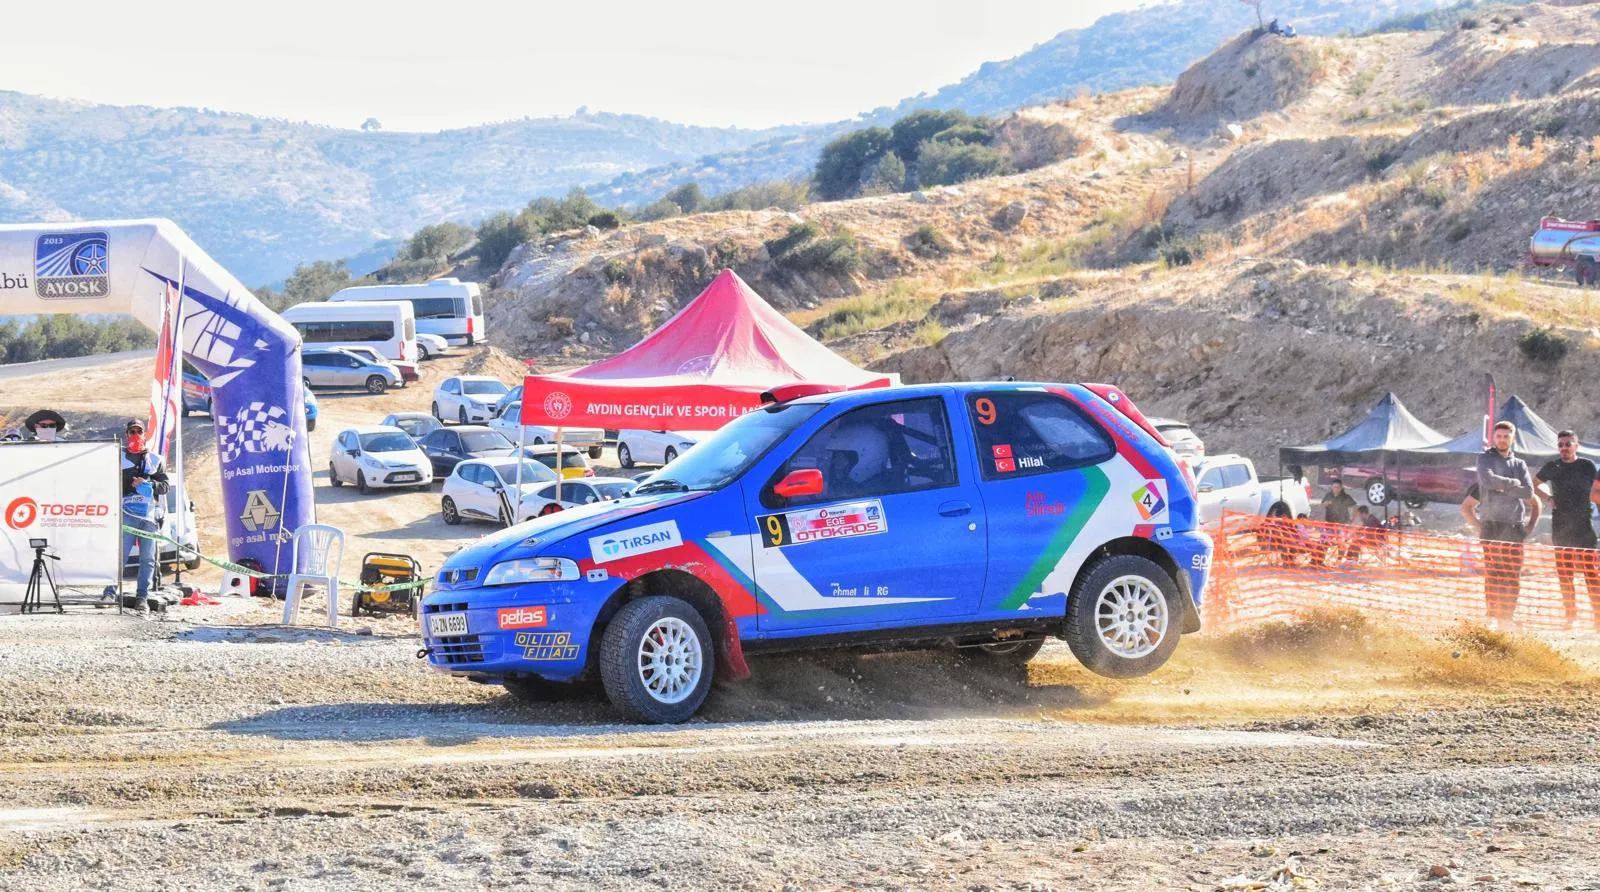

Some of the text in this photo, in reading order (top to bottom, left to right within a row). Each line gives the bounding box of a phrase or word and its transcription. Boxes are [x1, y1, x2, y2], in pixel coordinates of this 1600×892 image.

[0, 272, 29, 289] bü
[45, 280, 102, 295] AYOSK
[586, 402, 623, 416] AYDIN
[623, 402, 674, 420] GENÇLİK
[676, 404, 692, 417] VE
[694, 404, 727, 418] SPOR
[729, 402, 740, 418] İL
[975, 397, 998, 426] 9
[1018, 455, 1045, 469] Hilal
[223, 469, 235, 480] Ege
[236, 465, 255, 477] Asal
[1142, 492, 1152, 508] 4
[40, 504, 109, 516] TOSFED
[825, 516, 847, 527] EGE
[246, 531, 266, 543] asal
[766, 515, 784, 546] 9
[796, 522, 880, 541] OTOKROS
[439, 617, 448, 633] ZN
[448, 615, 466, 632] 6699
[500, 609, 544, 628] petlas
[517, 634, 568, 646] OLIO
[526, 647, 576, 658] FIAT
